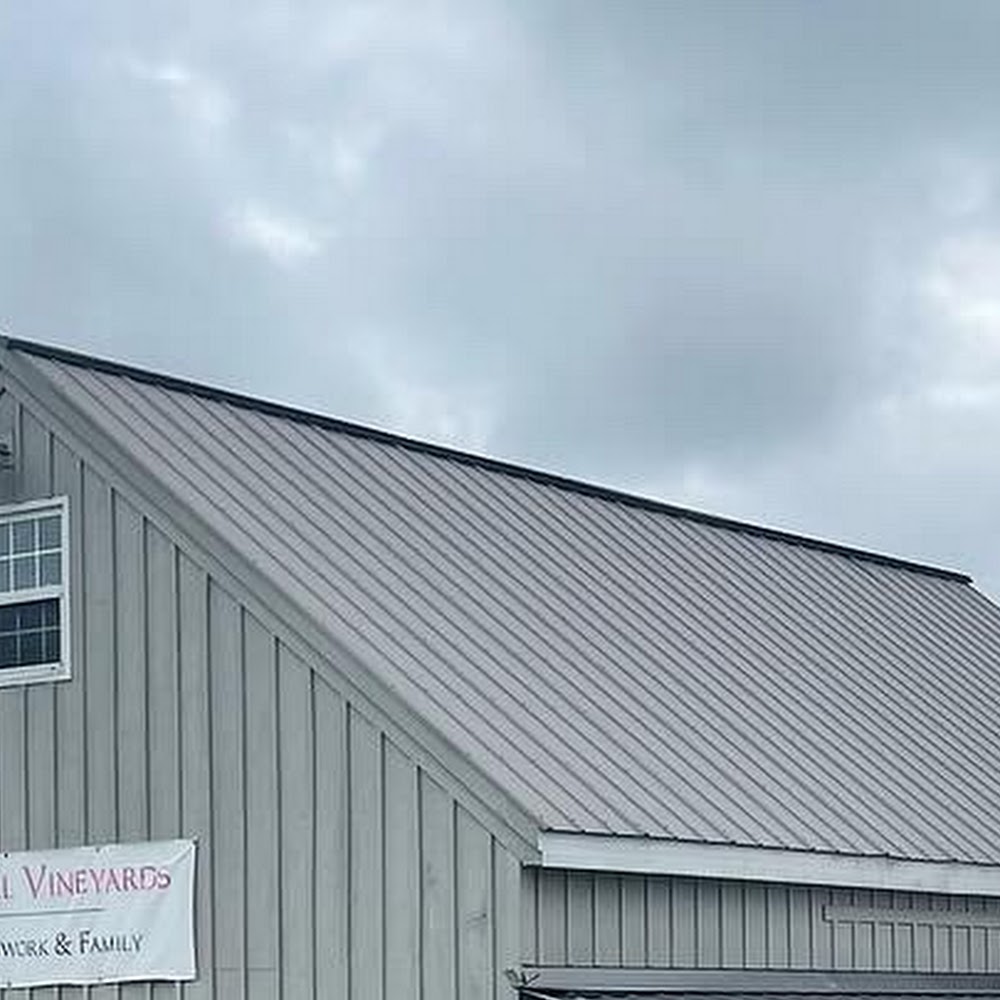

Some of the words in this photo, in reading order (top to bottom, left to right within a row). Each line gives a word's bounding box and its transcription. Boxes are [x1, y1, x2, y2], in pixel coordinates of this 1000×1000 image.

[22, 864, 172, 899] VINEYARDS
[54, 931, 73, 957] &
[79, 930, 143, 955] FAMILY
